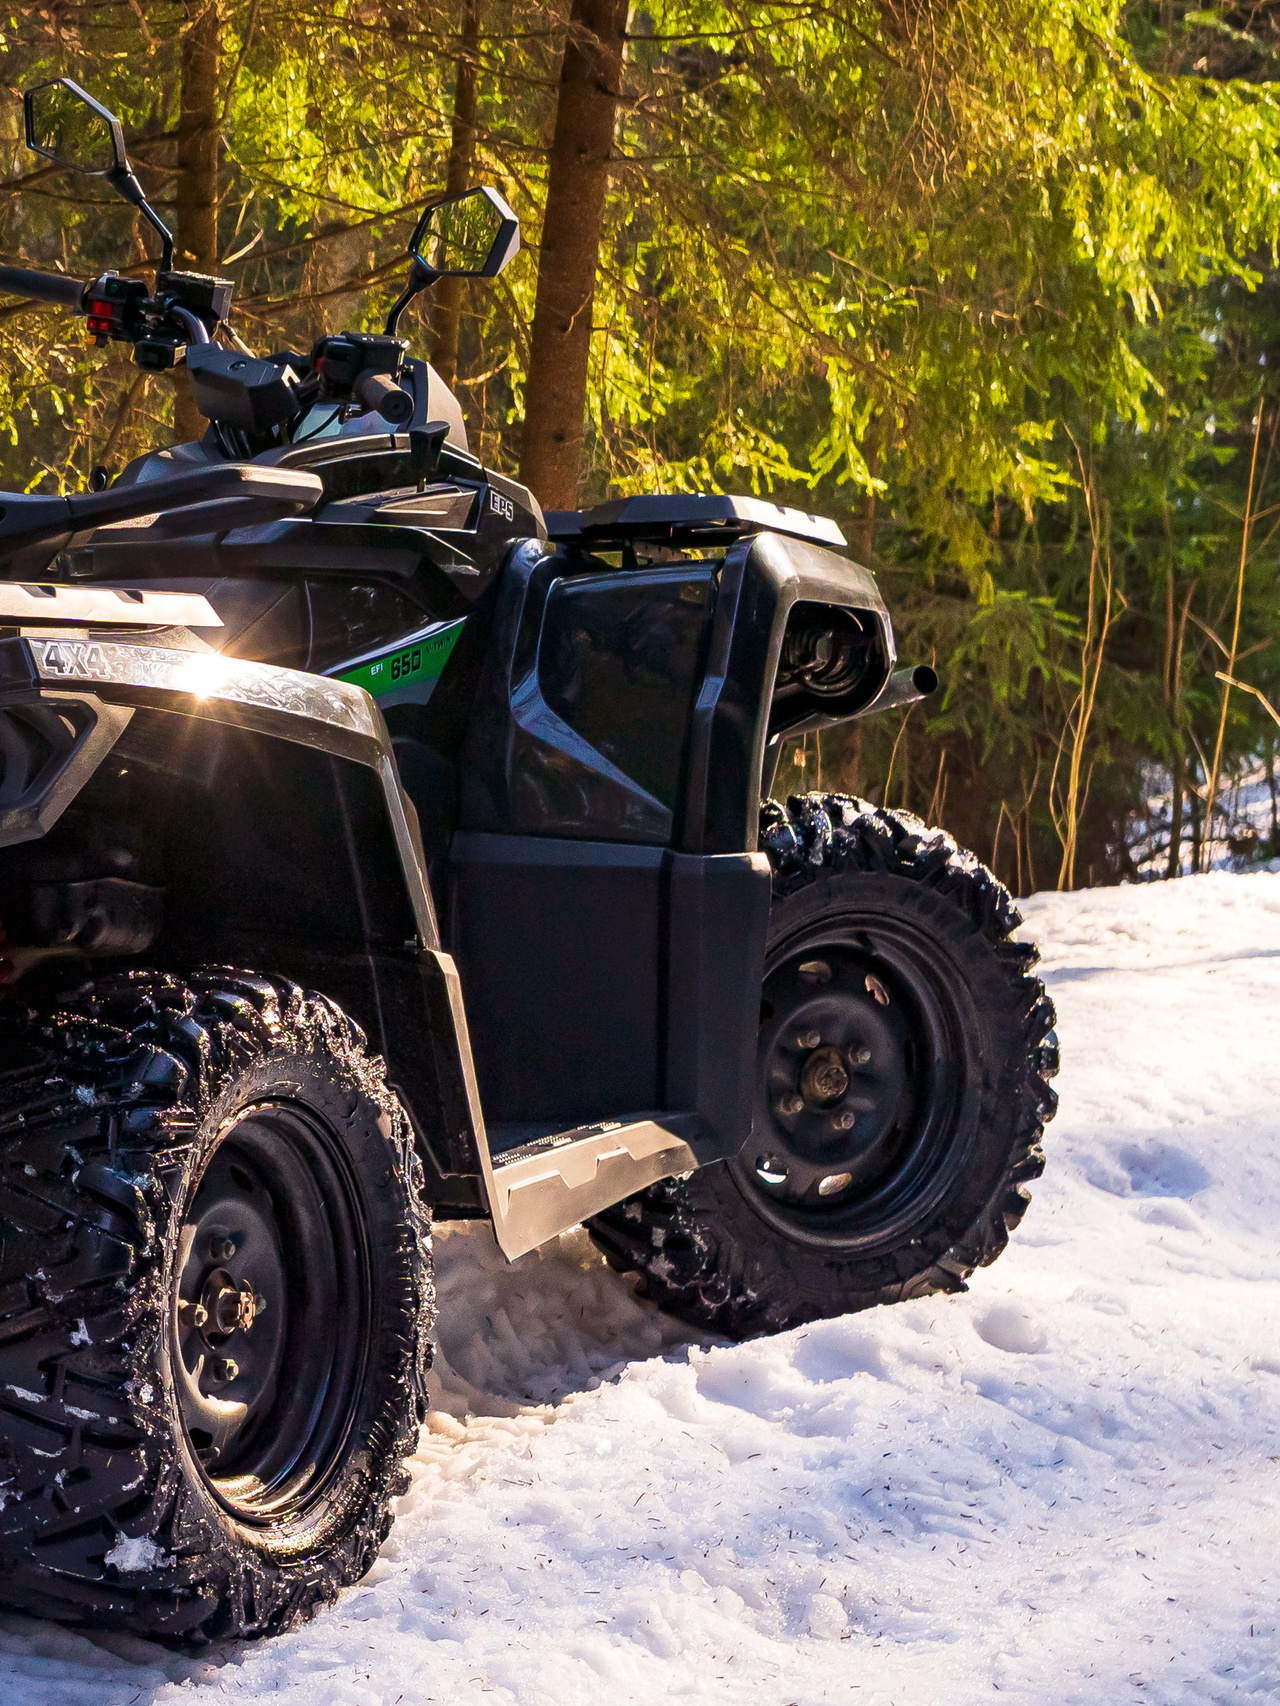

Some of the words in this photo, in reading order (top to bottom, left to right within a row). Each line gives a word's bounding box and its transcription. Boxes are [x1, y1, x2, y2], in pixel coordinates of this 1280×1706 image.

[490, 490, 514, 522] EPS
[43, 641, 111, 679] 4X4
[370, 662, 384, 676] EFI
[391, 648, 422, 681] 650
